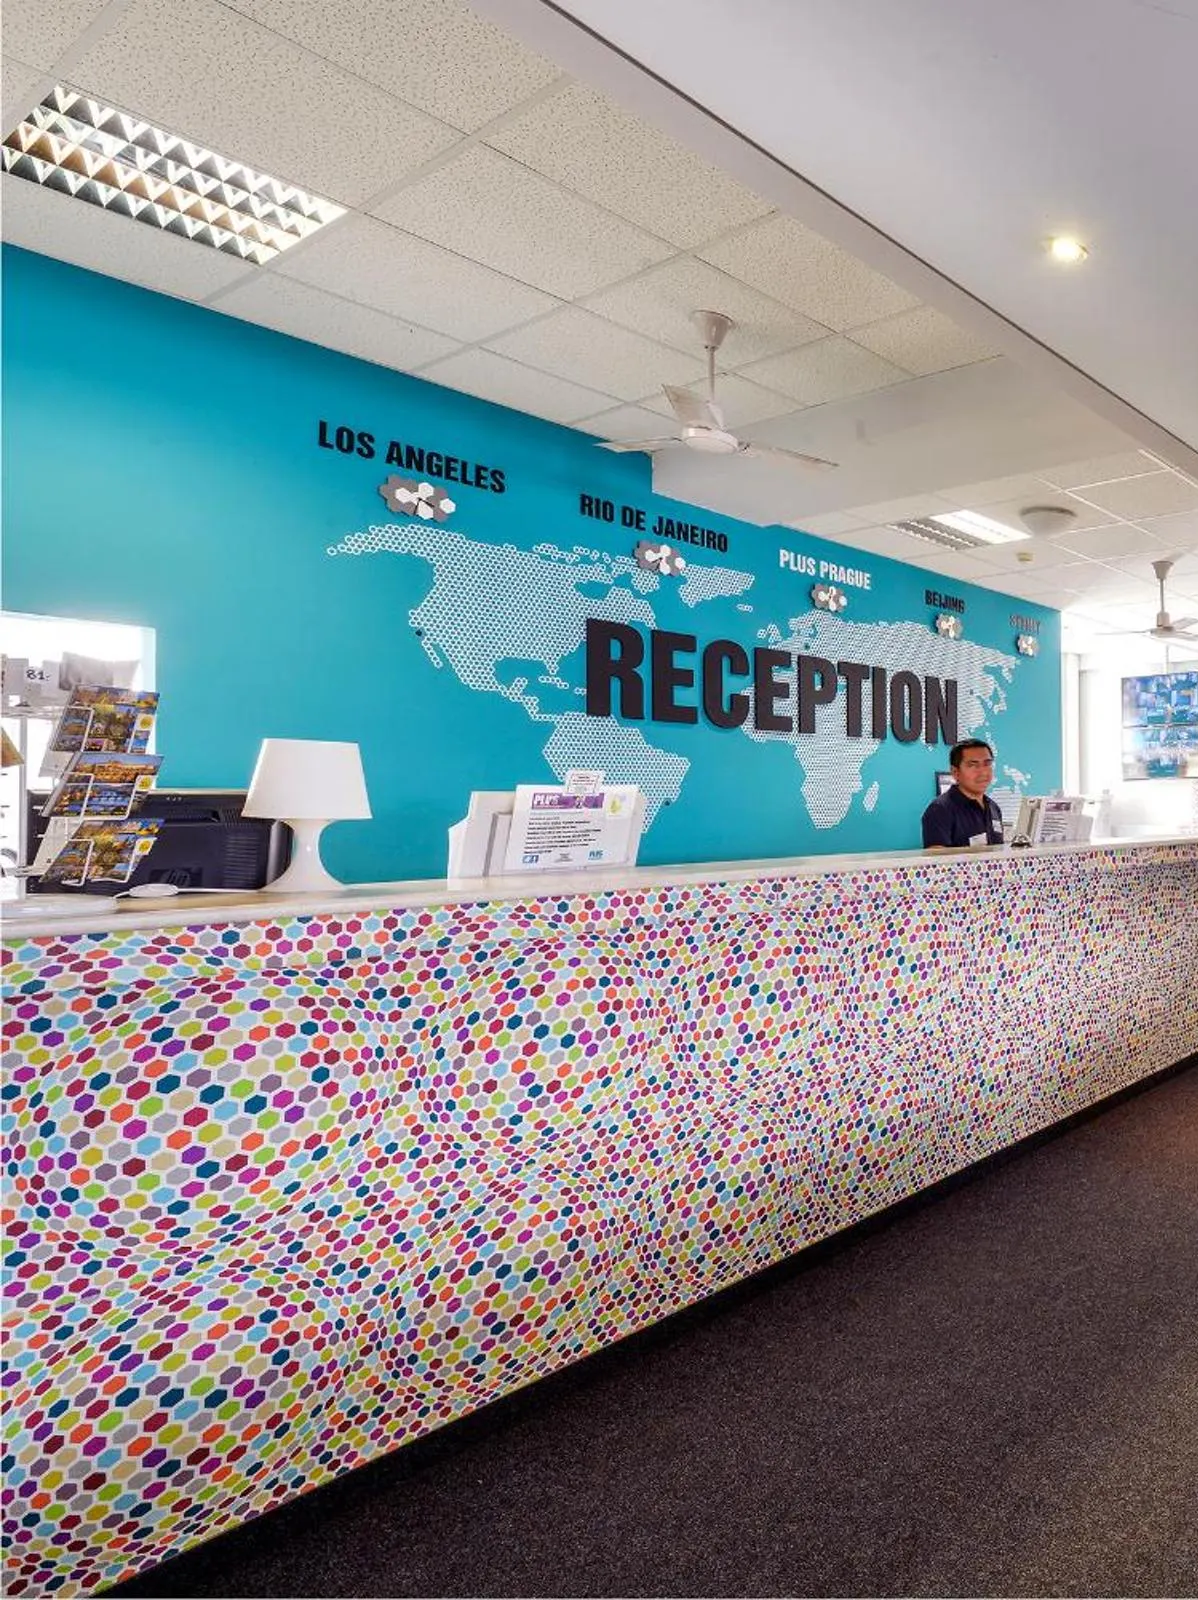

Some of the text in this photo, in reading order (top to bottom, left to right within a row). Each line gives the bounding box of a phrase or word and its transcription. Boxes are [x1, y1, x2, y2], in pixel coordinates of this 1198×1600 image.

[318, 420, 506, 493] LOS ANGELES
[579, 493, 728, 553] RIO DE JANEIRO
[778, 549, 872, 590] PLUS PRAGUE
[924, 589, 966, 614] BEIJING
[586, 618, 958, 746] RECEPTION
